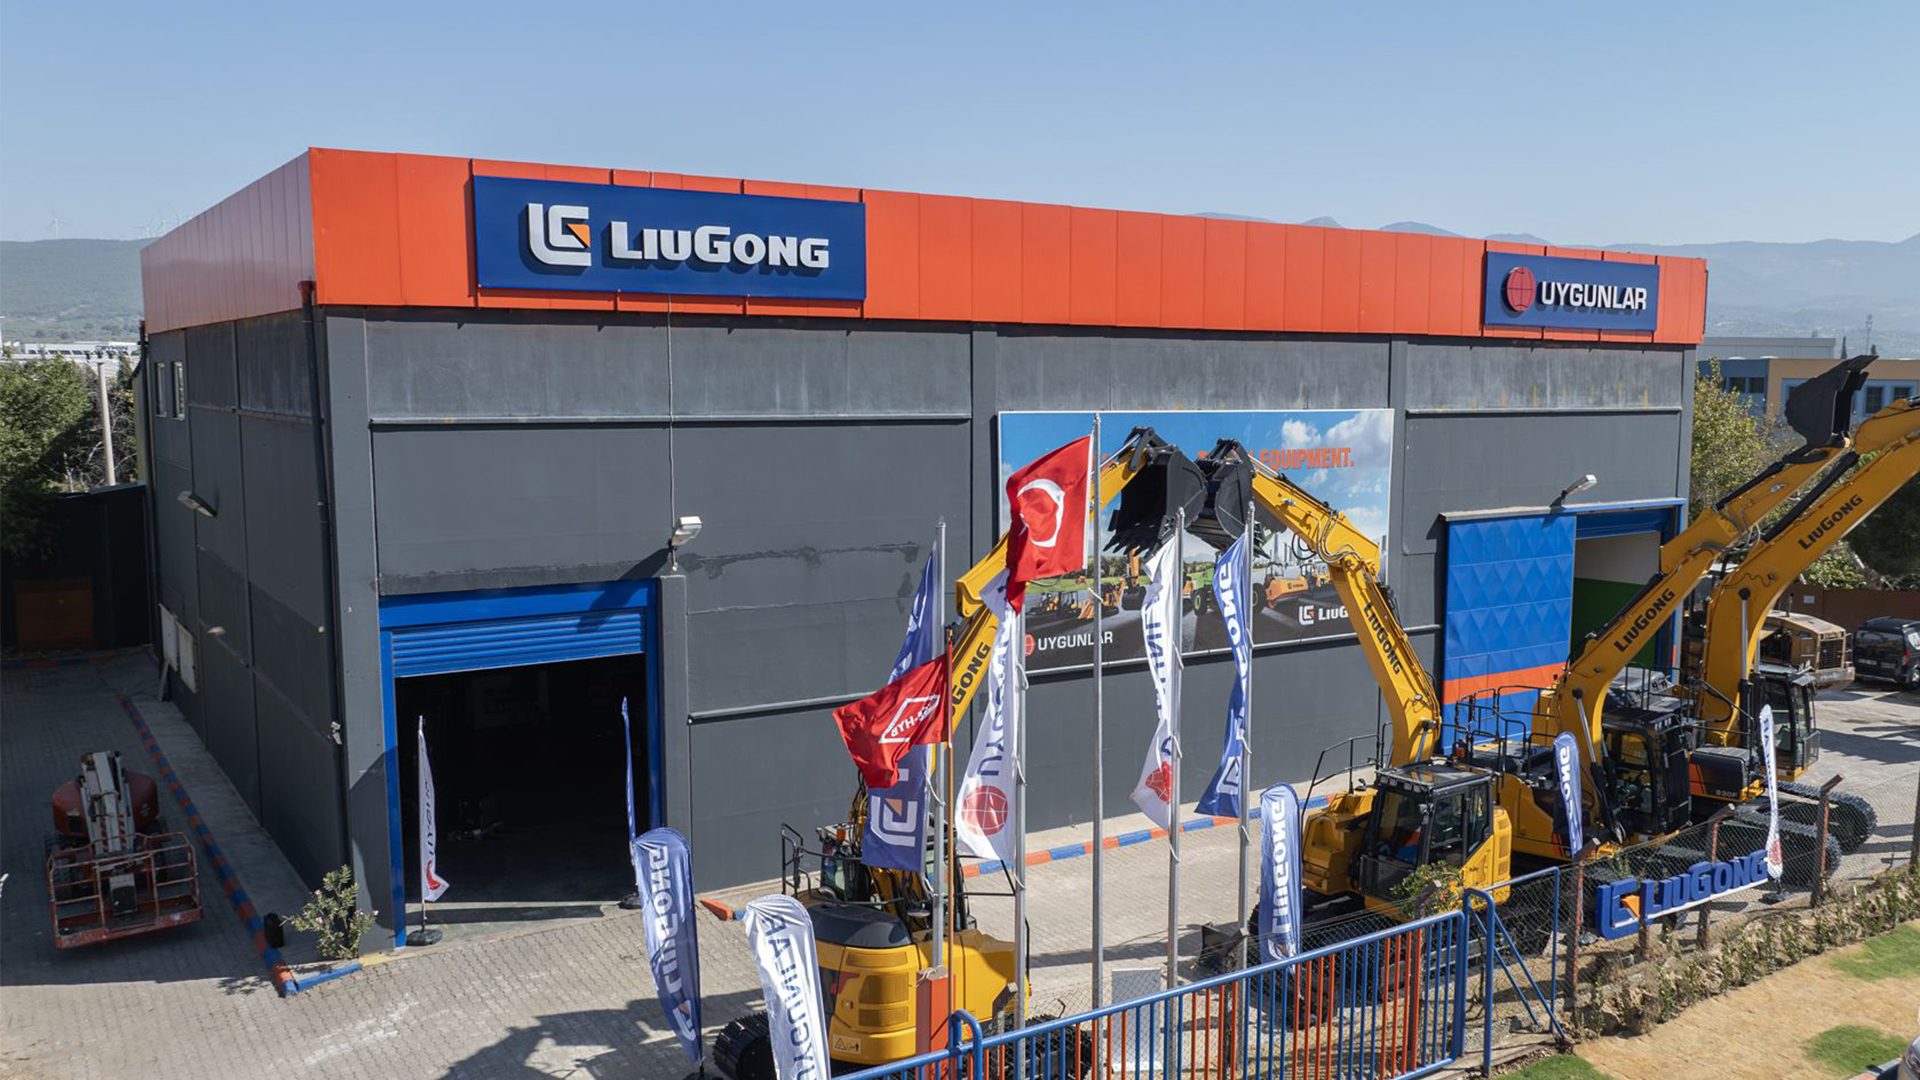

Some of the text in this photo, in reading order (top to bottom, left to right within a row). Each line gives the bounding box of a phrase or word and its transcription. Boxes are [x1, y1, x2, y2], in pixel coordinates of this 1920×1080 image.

[1541, 280, 1648, 310] UYGUNLAR
[1796, 494, 1864, 550] LIUGONG
[1318, 606, 1349, 621] LIUG
[1364, 602, 1403, 675] LIUGONG
[1613, 588, 1676, 652] LIUGONG
